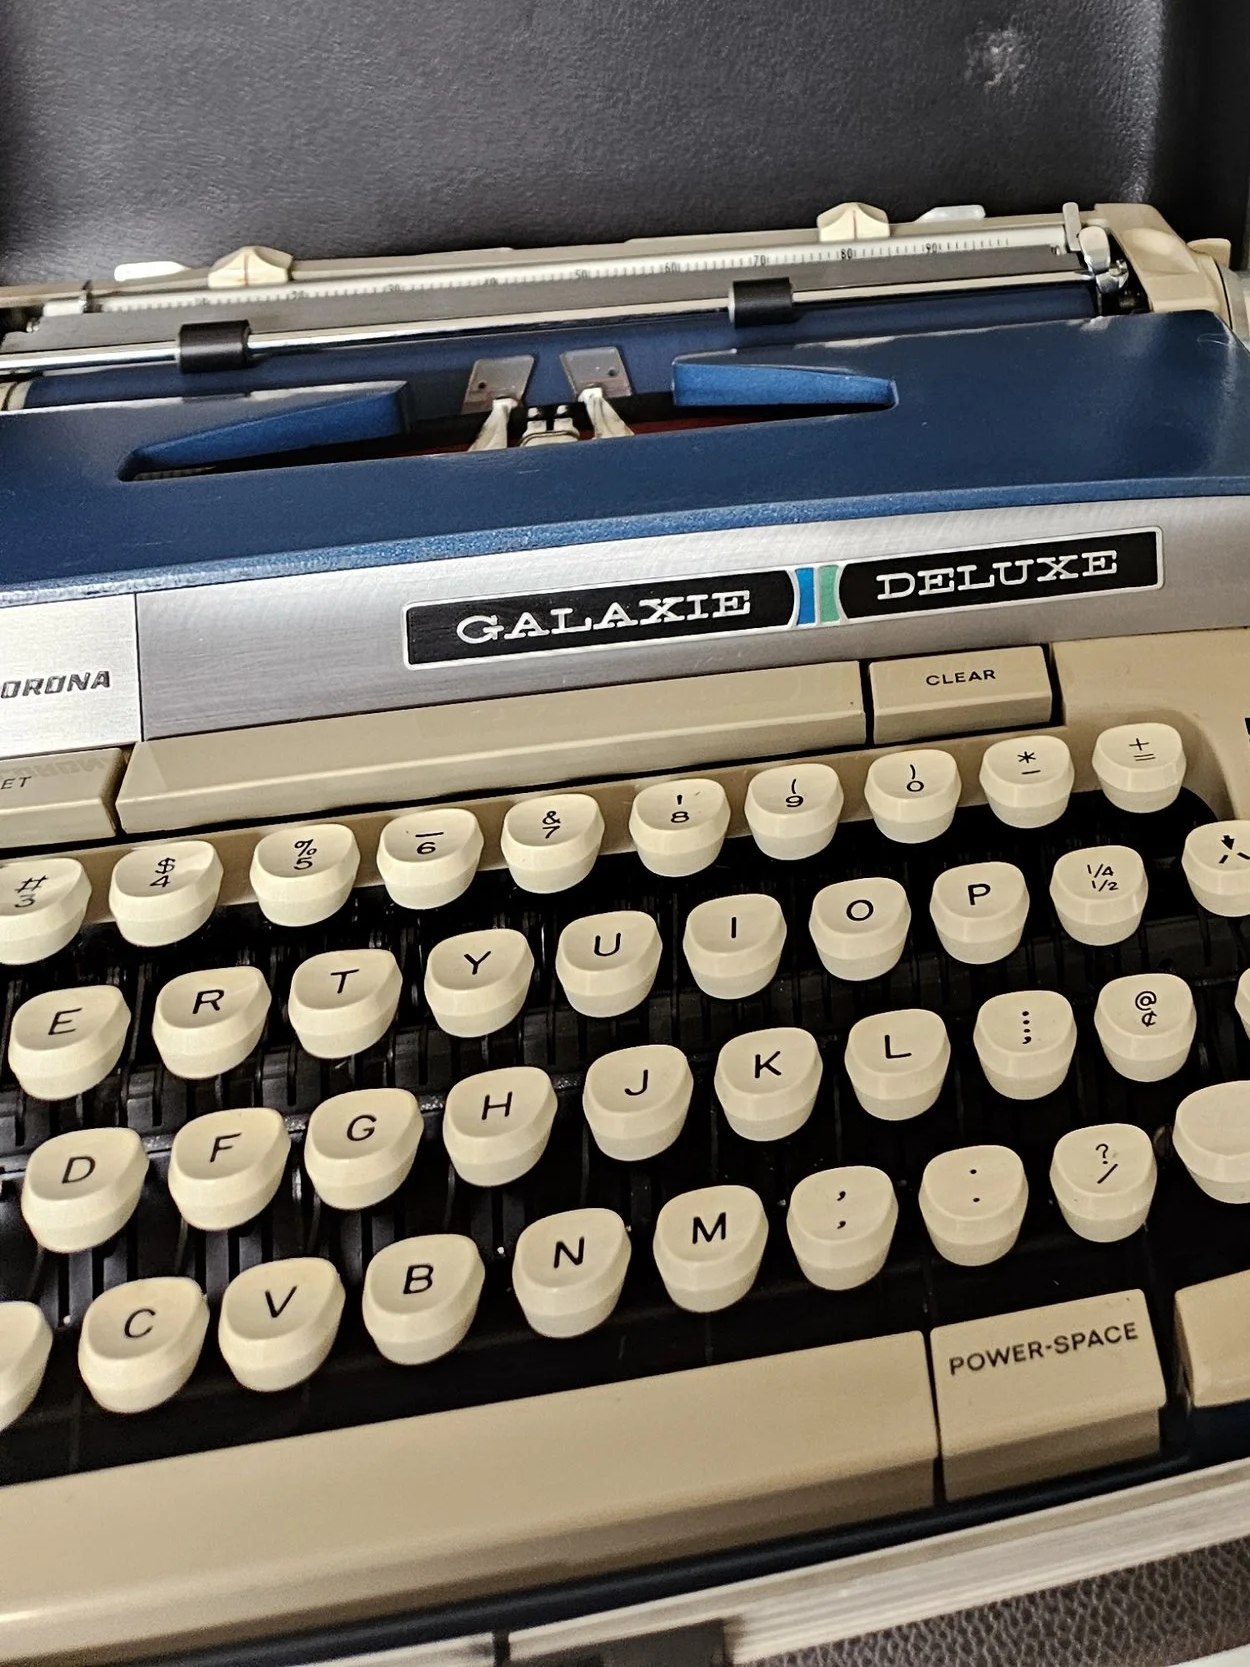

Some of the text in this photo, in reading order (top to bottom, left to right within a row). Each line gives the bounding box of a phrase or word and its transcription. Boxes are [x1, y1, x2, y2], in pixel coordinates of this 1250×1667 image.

[754, 254, 766, 266] 70
[841, 247, 853, 260] 80
[926, 242, 939, 254] 90
[456, 549, 1118, 644] GALAXIE DELUXE
[925, 669, 996, 686] CLEAR
[785, 795, 804, 808] 9
[541, 810, 562, 826] &
[670, 810, 690, 824] 8
[542, 825, 561, 840] 7
[294, 838, 318, 858] %
[416, 841, 436, 855] 6
[154, 857, 176, 875] $
[293, 856, 313, 871] 5
[15, 875, 49, 894] #
[149, 874, 171, 888] 4
[14, 894, 36, 908] 3
[967, 883, 991, 906] P
[845, 899, 874, 922] O
[730, 916, 737, 939] I
[593, 932, 622, 957] U
[463, 950, 492, 976] Y
[330, 968, 360, 995] T
[192, 989, 225, 1015] R
[1134, 990, 1158, 1012] @
[47, 1007, 82, 1036] E
[884, 1034, 913, 1060] L
[754, 1050, 782, 1079] K
[624, 1069, 649, 1097] J
[481, 1091, 513, 1121] H
[346, 1114, 377, 1142] G
[209, 1133, 241, 1163] F
[61, 1155, 96, 1185] D
[691, 1211, 727, 1245] M
[553, 1236, 585, 1269] N
[402, 1263, 434, 1295] B
[264, 1286, 298, 1319] V
[123, 1308, 156, 1339] C
[948, 1321, 1139, 1376] POWER-SPACE
